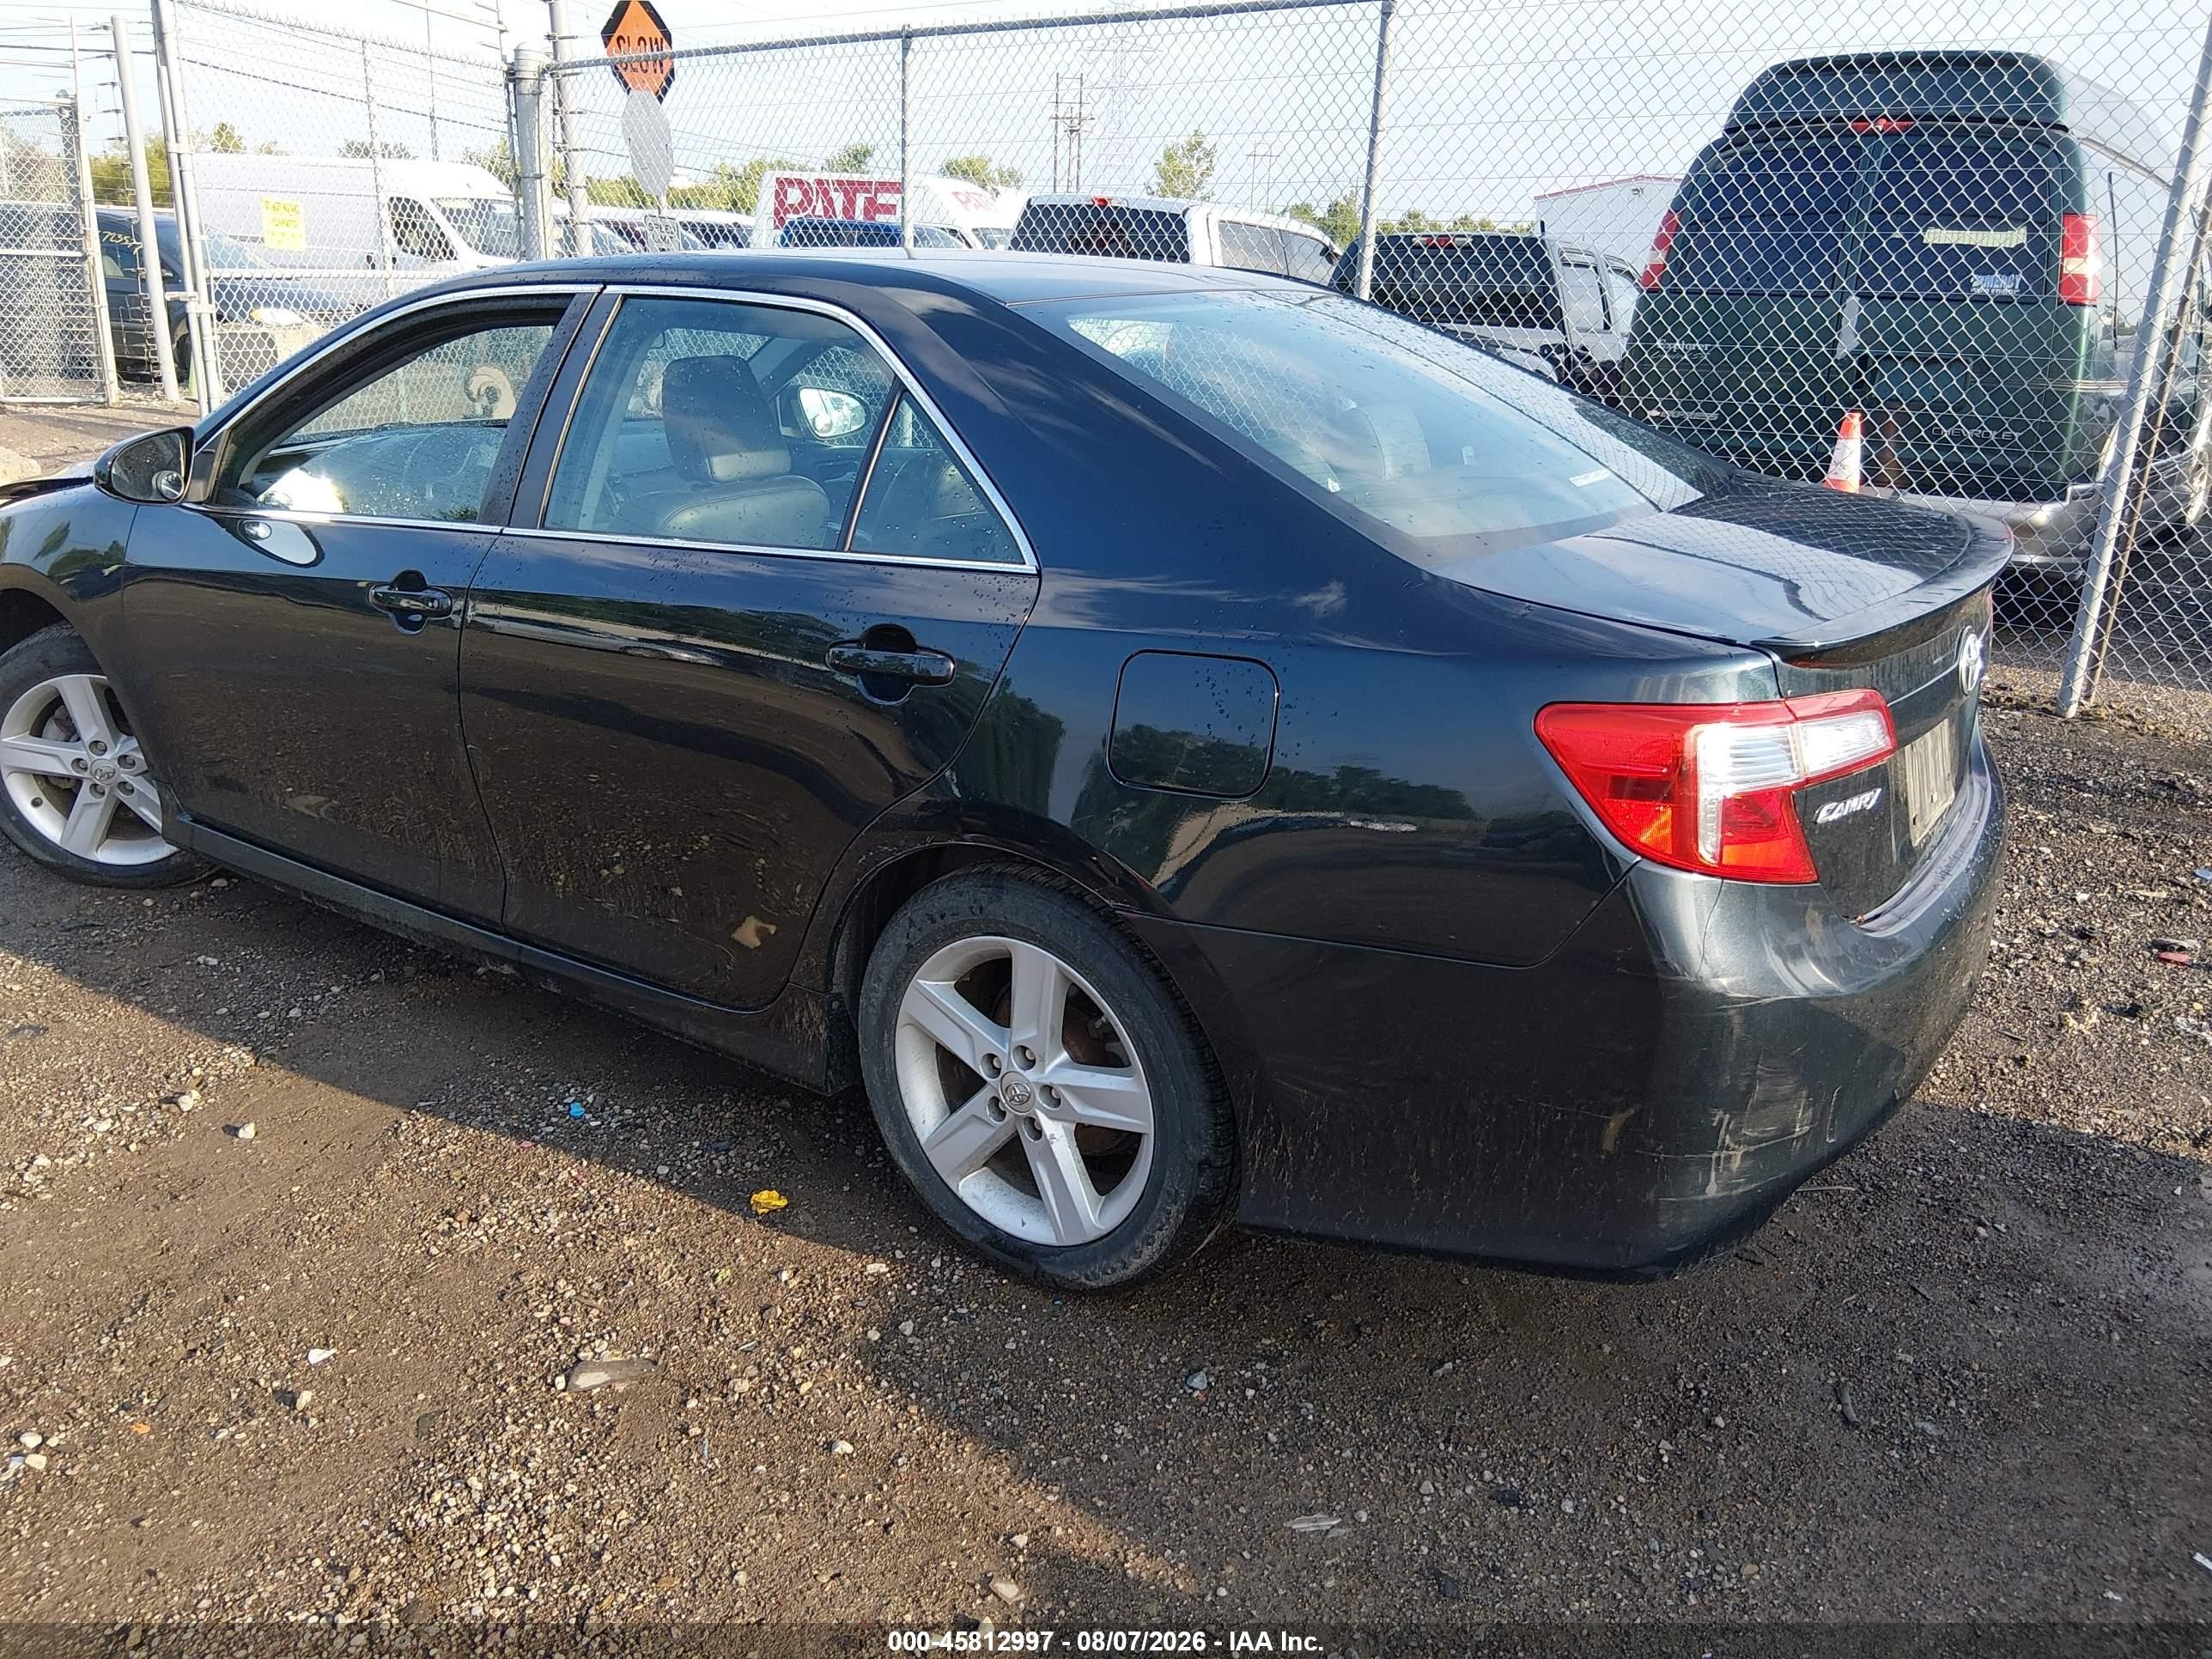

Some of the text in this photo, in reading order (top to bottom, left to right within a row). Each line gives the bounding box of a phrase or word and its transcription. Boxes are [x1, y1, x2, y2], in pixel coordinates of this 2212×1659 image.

[616, 34, 665, 74] SLOW
[1660, 410, 1720, 422] EXPRESS
[1931, 427, 2021, 441] CHEVROLET
[1813, 787, 1882, 824] CAMRY
